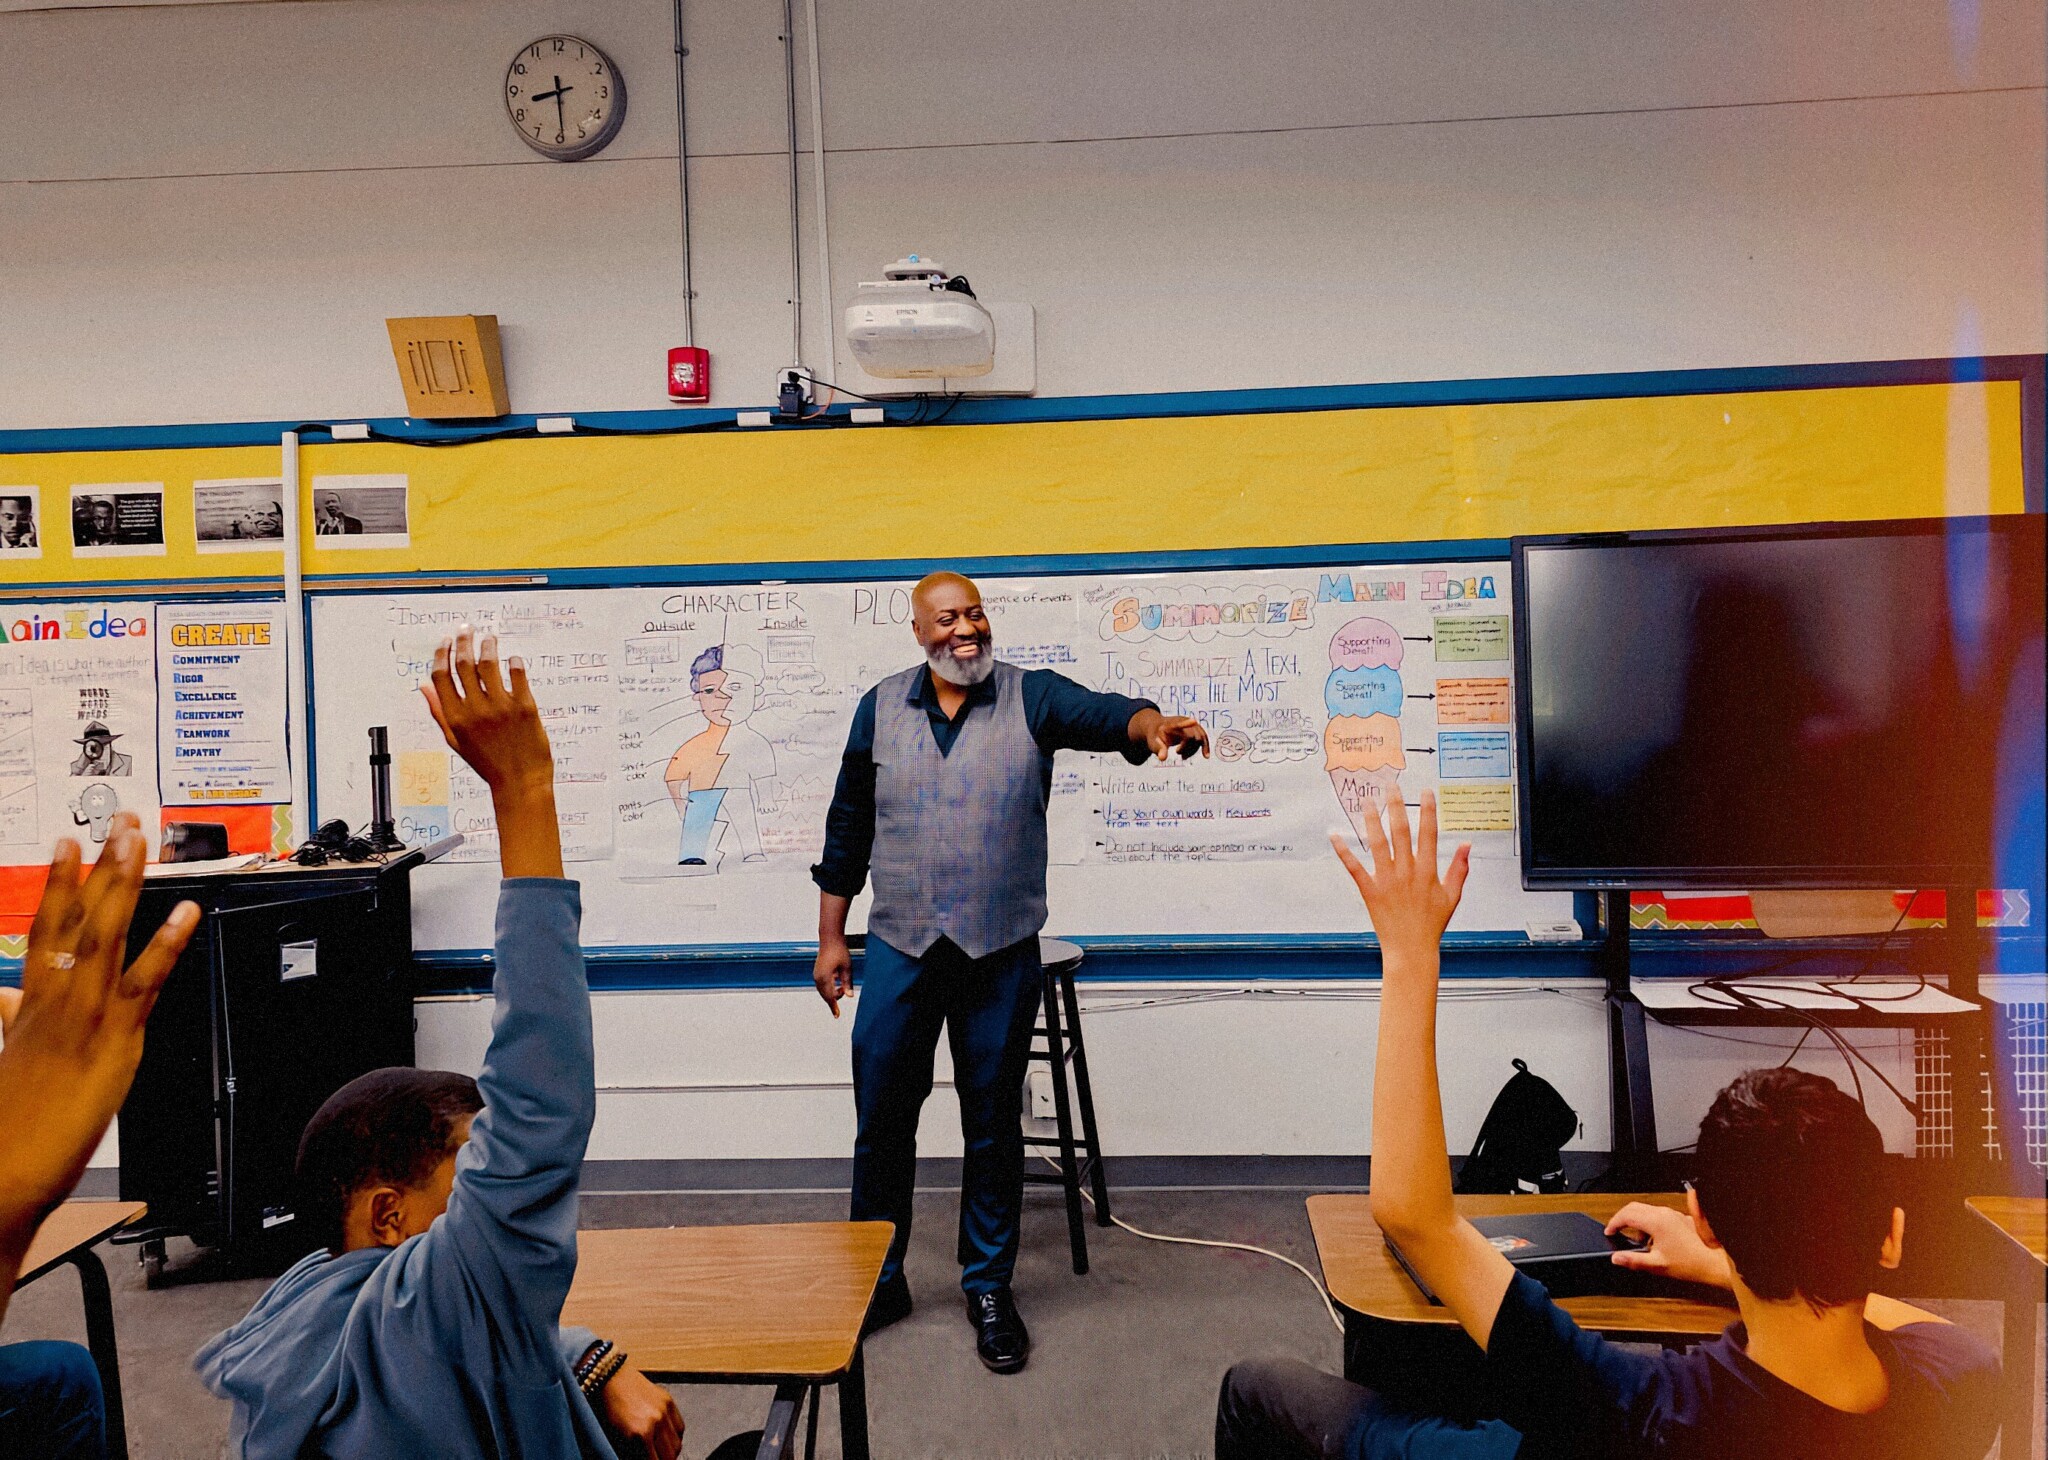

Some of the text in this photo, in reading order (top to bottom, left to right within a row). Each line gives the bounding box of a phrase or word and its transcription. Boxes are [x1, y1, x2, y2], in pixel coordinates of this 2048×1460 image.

[531, 46, 539, 57] 11
[553, 40, 564, 52] 12
[513, 63, 526, 75] 10
[595, 62, 602, 75] 2
[509, 85, 519, 98] 9
[600, 86, 608, 98] 3
[516, 108, 525, 122] 8
[592, 108, 601, 119] 4
[533, 126, 541, 138] 7
[577, 123, 586, 138] 5
[1317, 571, 1496, 603] MAIN IDEA
[662, 591, 805, 614] CHARACTER
[1023, 592, 1038, 602] of
[853, 588, 915, 624] PLO
[399, 607, 469, 626] IDENTIFY
[476, 609, 496, 620] THE
[544, 603, 577, 618] IDEA
[64, 609, 147, 639] Idea
[643, 619, 696, 633] Outside
[763, 615, 808, 630] Inside
[171, 622, 271, 647] CREATE
[1338, 636, 1391, 648] Supporting
[1343, 645, 1374, 656] Detail
[173, 655, 241, 665] COMMITMENT
[541, 655, 566, 668] THE
[1138, 651, 1238, 678] SUMMARIZE
[1244, 648, 1256, 675] A
[173, 673, 204, 683] RIGOR
[1129, 677, 1200, 705] DESCRIBE
[1204, 675, 1229, 703] THE
[1239, 675, 1286, 703] MOST
[1335, 680, 1386, 692] Supporting
[175, 690, 237, 702] EXCELLENCE
[1343, 691, 1372, 700] Detail
[175, 710, 244, 720] ACHIEVEMENT
[1252, 709, 1263, 719] IN
[1246, 718, 1269, 728] OWN
[175, 728, 231, 738] TEAMWORK
[621, 741, 644, 750] color
[1332, 733, 1384, 746] Supporting
[175, 746, 222, 757] EMPATHY
[1341, 743, 1372, 753] Detail
[626, 772, 647, 781] color
[1100, 775, 1134, 794] Write
[1138, 780, 1169, 793] about
[1178, 779, 1195, 793] the
[1340, 778, 1381, 798] Main
[417, 787, 432, 803] 3
[469, 788, 490, 799] BOT
[619, 801, 642, 814] pants
[1103, 801, 1128, 820] Use
[1133, 809, 1158, 820] your
[1162, 809, 1184, 819] own
[1186, 808, 1214, 819] words
[622, 812, 645, 822] color
[401, 817, 440, 843] Step
[1106, 820, 1131, 828] from
[1156, 820, 1179, 828] text
[1105, 835, 1124, 852] Do
[1126, 842, 1145, 852] not
[1129, 853, 1155, 862] about
[1163, 852, 1179, 861] the
